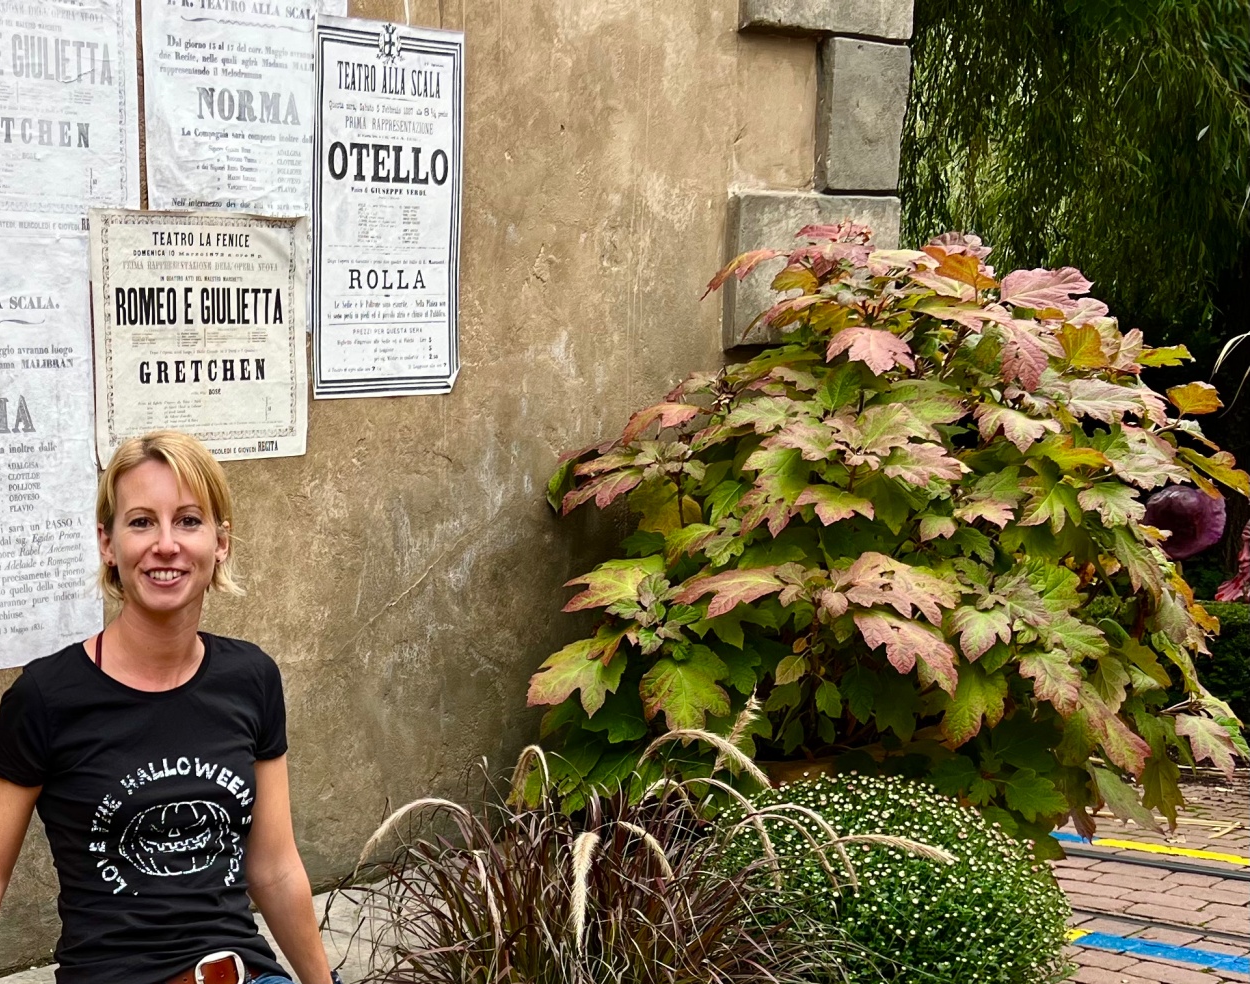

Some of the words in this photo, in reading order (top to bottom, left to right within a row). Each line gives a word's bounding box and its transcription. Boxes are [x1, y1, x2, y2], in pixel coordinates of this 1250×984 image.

[200, 1, 246, 12] TEATRO
[251, 3, 280, 17] ALLA
[286, 7, 315, 20] SCAL
[12, 34, 113, 86] GIULIETTA
[337, 61, 376, 92] TEATRO
[382, 66, 405, 95] ALLA
[411, 70, 440, 99] SCALA
[196, 87, 301, 125] NORMA
[345, 116, 367, 129] PRIMA
[372, 118, 433, 135] RAPPRESENTAZIONE
[328, 142, 448, 186] OTELLO
[153, 232, 194, 246] TEATRO
[199, 233, 212, 246] LA
[216, 234, 250, 248] FENICE
[349, 269, 426, 290] ROLLA
[9, 296, 60, 310] SCALA.
[115, 287, 176, 326] ROMEO
[184, 287, 193, 324] E
[201, 288, 283, 325] GIULIETTA
[17, 347, 49, 355] avranno
[51, 345, 73, 356] luogo
[21, 359, 74, 370] MALIBRAN
[139, 358, 266, 384] GRETCHEN
[9, 444, 34, 453] inoltre
[39, 442, 57, 452] dalle
[91, 793, 122, 832] THE
[120, 756, 254, 807] HALLOWEEN
